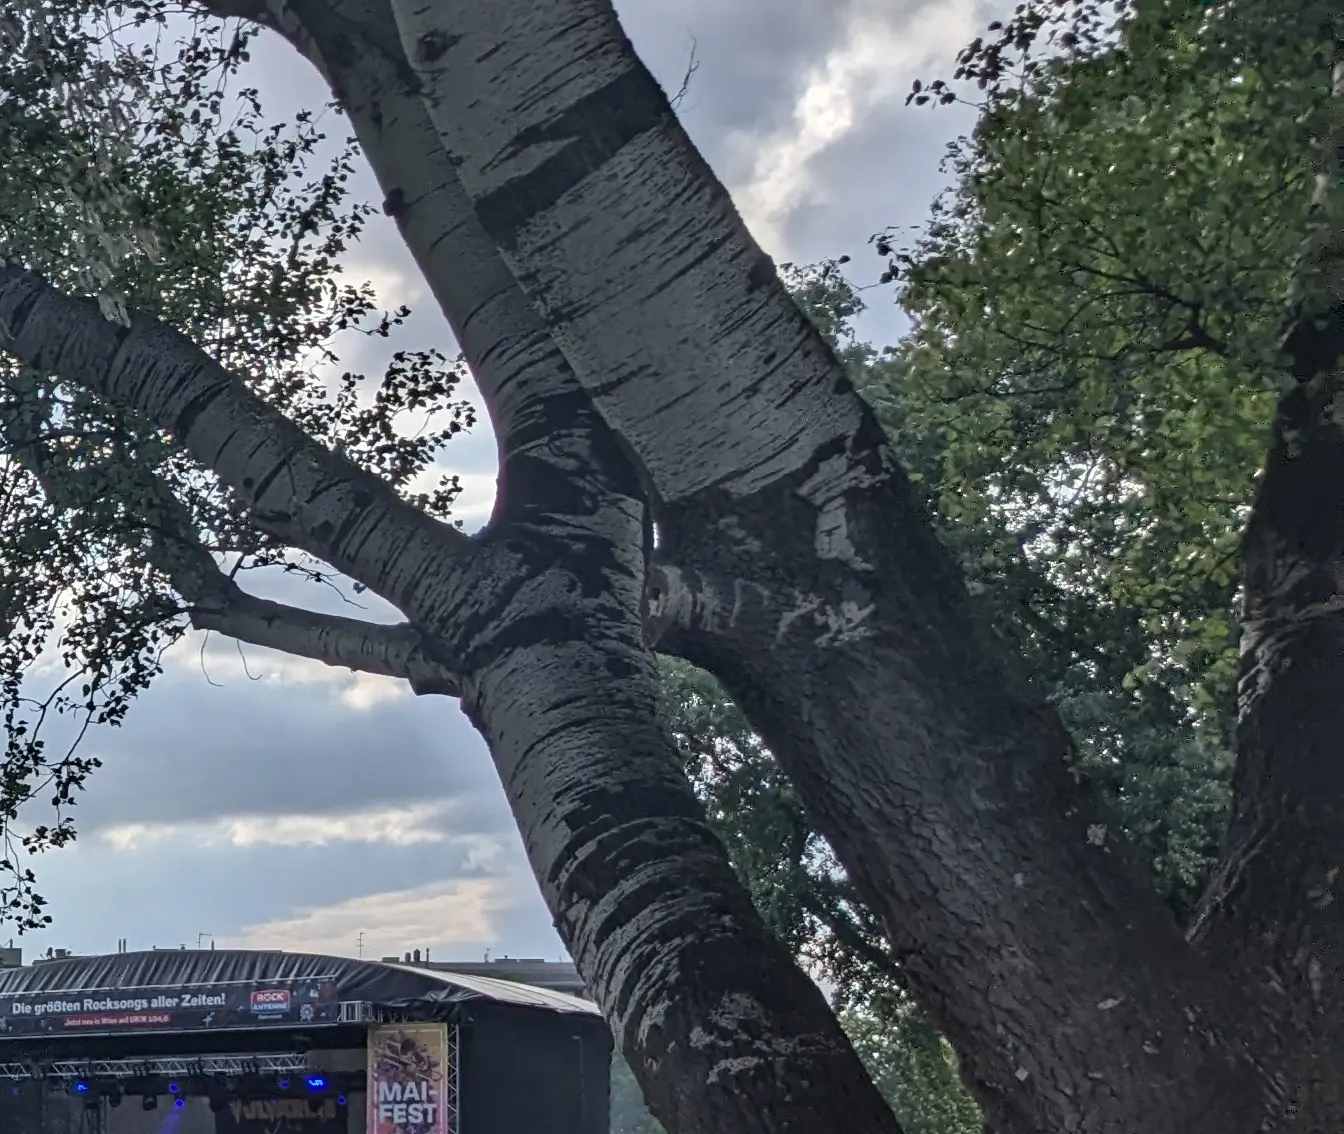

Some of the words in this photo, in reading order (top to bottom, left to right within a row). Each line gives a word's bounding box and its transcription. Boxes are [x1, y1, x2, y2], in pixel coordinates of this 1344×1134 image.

[12, 1003, 30, 1015] Die
[32, 1002, 80, 1015] größten
[83, 999, 148, 1011] Rocksongs
[150, 997, 179, 1008] aller
[181, 993, 226, 1006] Zeiten!
[256, 993, 284, 1002] ROCK
[378, 1082, 439, 1102] MAI-
[378, 1105, 437, 1124] FEST
